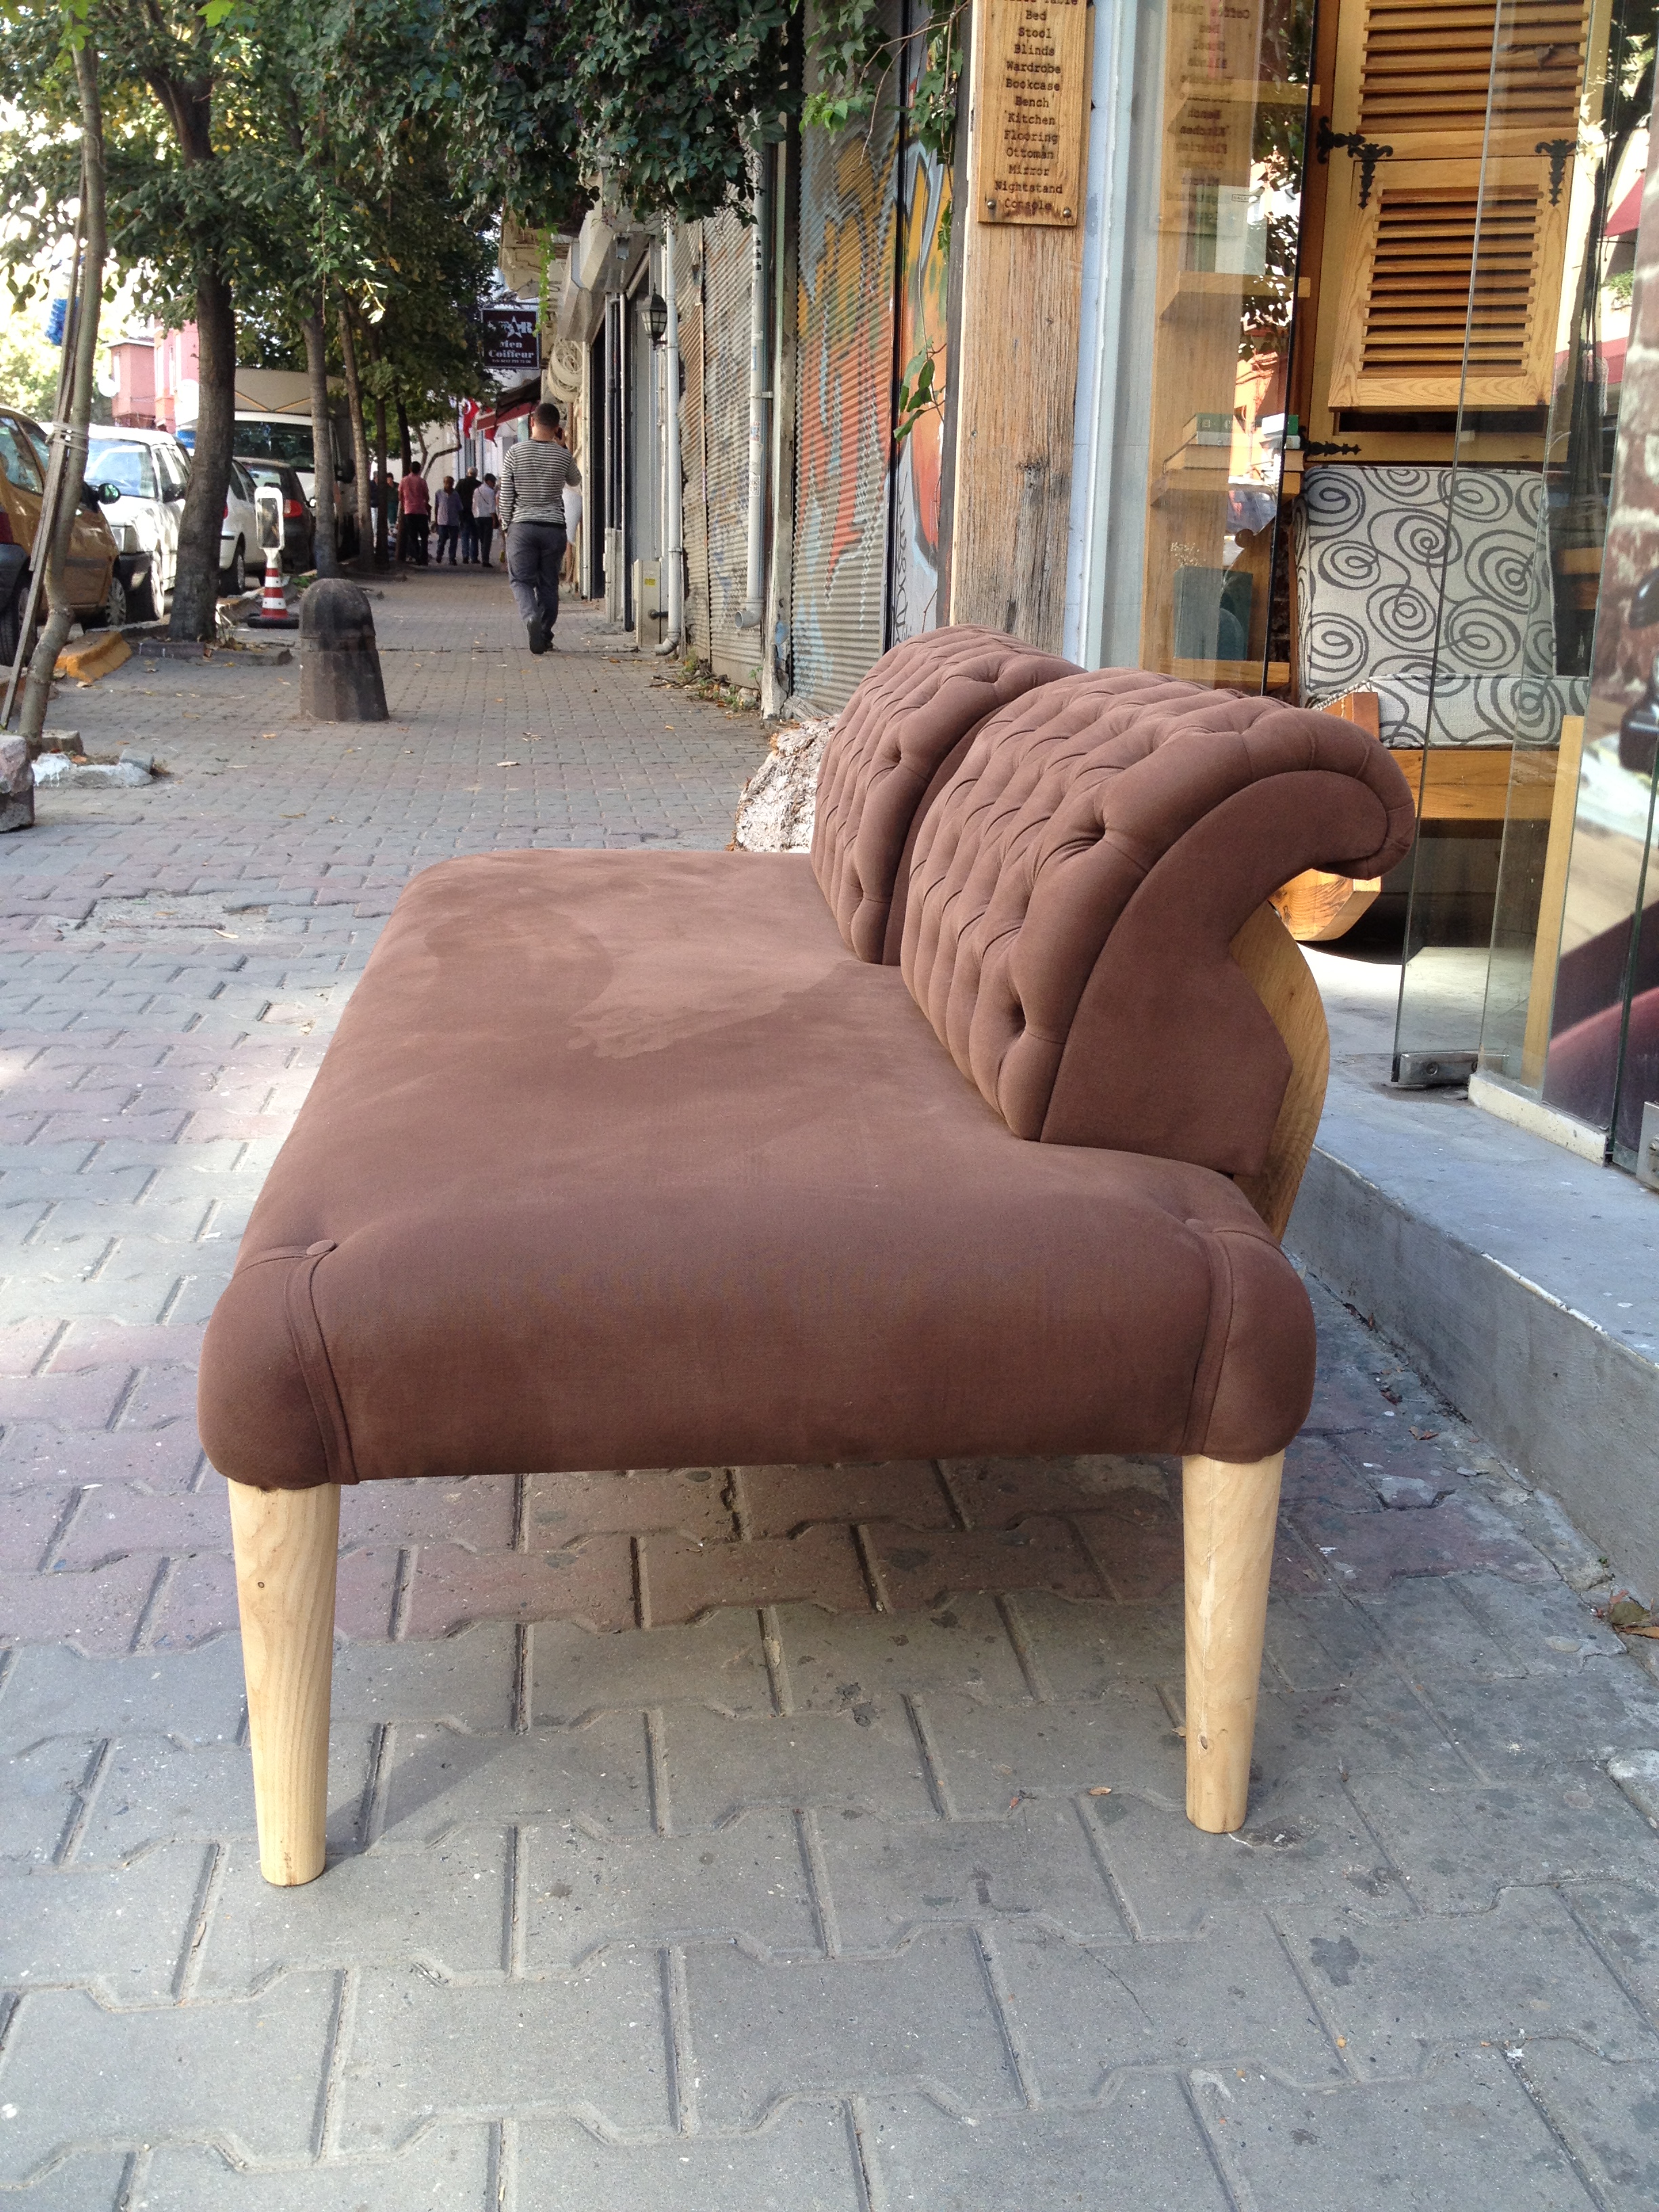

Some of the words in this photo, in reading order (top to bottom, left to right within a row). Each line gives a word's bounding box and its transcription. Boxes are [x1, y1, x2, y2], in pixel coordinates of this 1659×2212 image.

[1025, 9, 1047, 21] Bed
[1019, 27, 1052, 39] Stool
[1014, 43, 1055, 56] Blinds
[1006, 60, 1061, 74] Wardrobe
[1006, 77, 1060, 91] Bookcase
[1015, 96, 1049, 108] Bench
[1008, 112, 1056, 125] Kitchen
[1004, 129, 1059, 145] Flooring
[1006, 146, 1054, 160] Ottoman
[1008, 164, 1050, 176] Mirror
[994, 180, 1063, 194] Nightstand
[488, 350, 534, 359] Coiffeur
